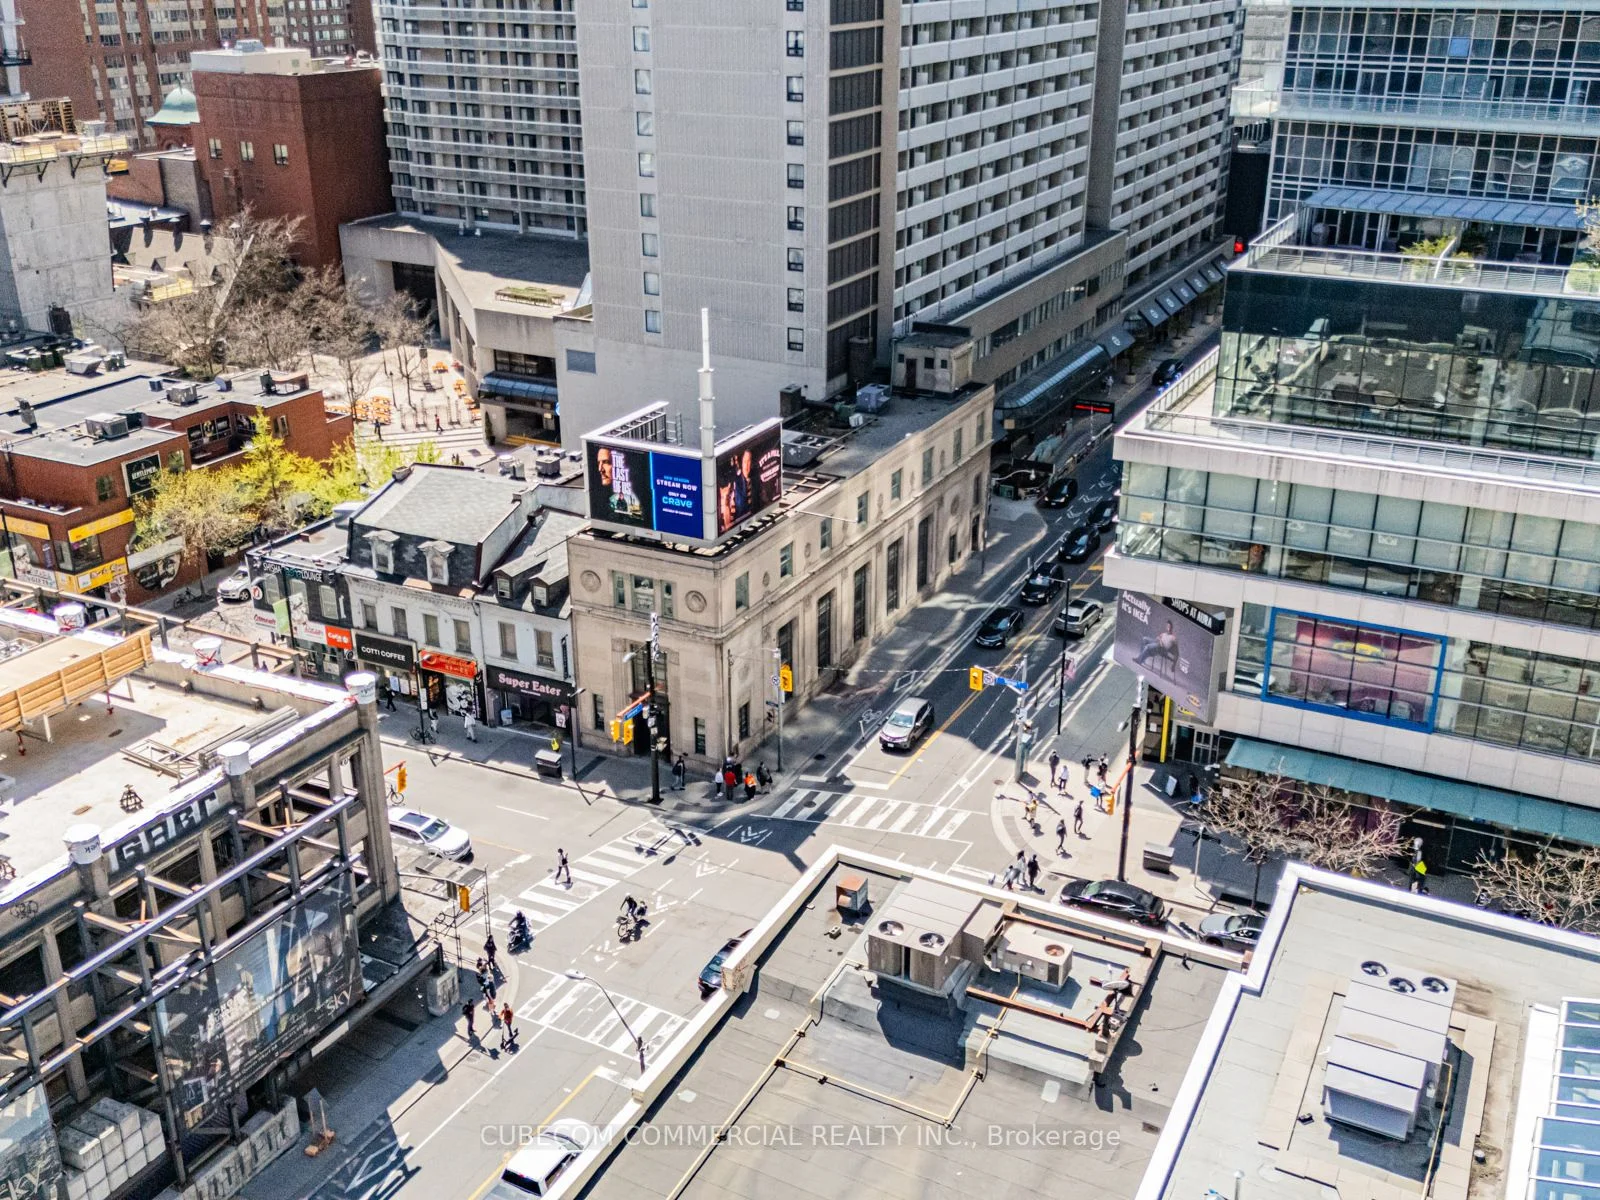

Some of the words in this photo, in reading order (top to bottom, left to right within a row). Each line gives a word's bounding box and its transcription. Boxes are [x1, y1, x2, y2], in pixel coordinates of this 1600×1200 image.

[611, 454, 624, 470] THE
[612, 468, 630, 482] LAST
[613, 482, 621, 494] OF
[621, 483, 632, 496] US
[656, 479, 681, 489] STREAM
[682, 484, 698, 492] NOW
[301, 570, 323, 582] LOUNGE
[1122, 590, 1152, 615] Actually,
[1121, 602, 1132, 614] it's
[1132, 608, 1149, 625] IKEA
[1171, 598, 1189, 616] SHOPS
[1189, 607, 1197, 619] AT
[1197, 611, 1212, 629] AURA
[361, 646, 380, 656] COTTI
[381, 650, 406, 662] COFFEE
[498, 673, 530, 690] Super
[532, 680, 561, 696] Eater
